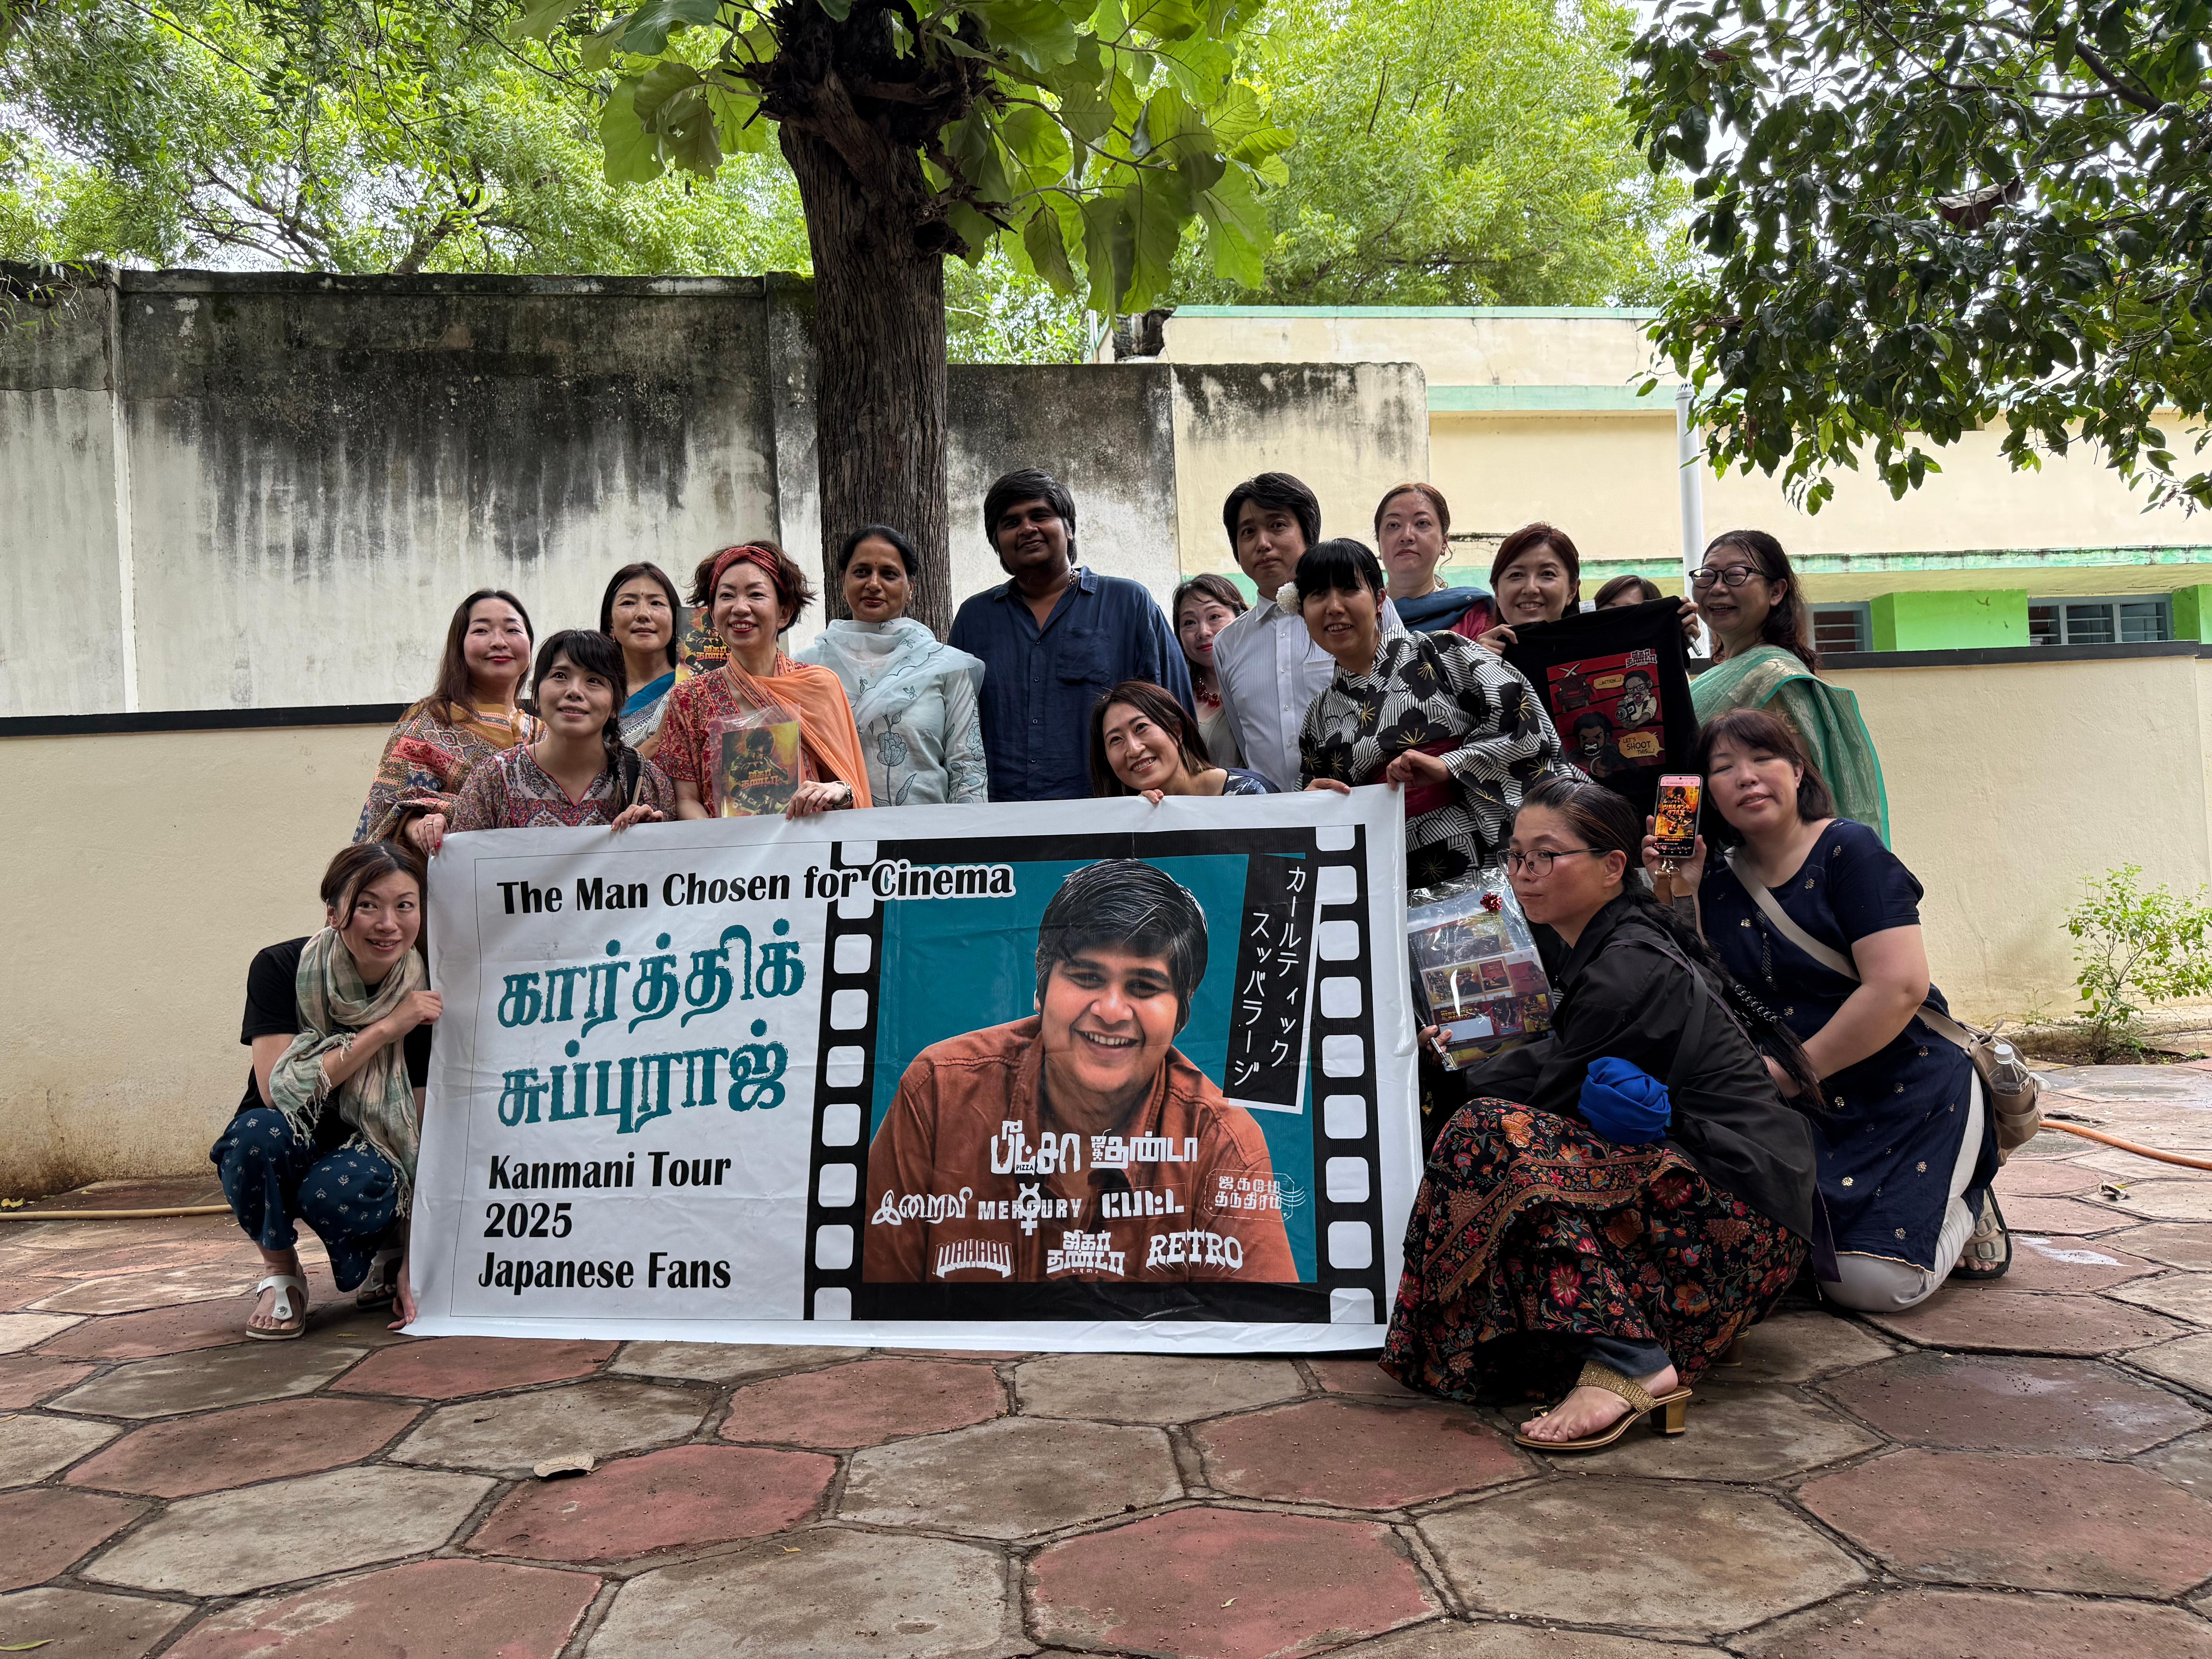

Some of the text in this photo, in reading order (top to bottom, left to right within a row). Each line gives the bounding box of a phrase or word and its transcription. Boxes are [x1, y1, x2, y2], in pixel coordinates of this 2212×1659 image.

[1627, 741, 1650, 750] SHOOT
[497, 863, 1013, 914] The Man Chosen for Cinema
[498, 918, 806, 1038] கார்த்திக்
[1271, 866, 1305, 1067] カールティック
[1235, 913, 1272, 1086] スッバラージ
[498, 1018, 788, 1134] சுப்புராஜ்
[489, 1151, 731, 1189] Kanmani Tour
[484, 1203, 572, 1238] 2025
[1063, 1230, 1111, 1251] ஜிகர்
[1046, 1249, 1125, 1276] தண்டா
[1146, 1228, 1243, 1272] RETRO
[479, 1252, 731, 1295] Japanese Fans
